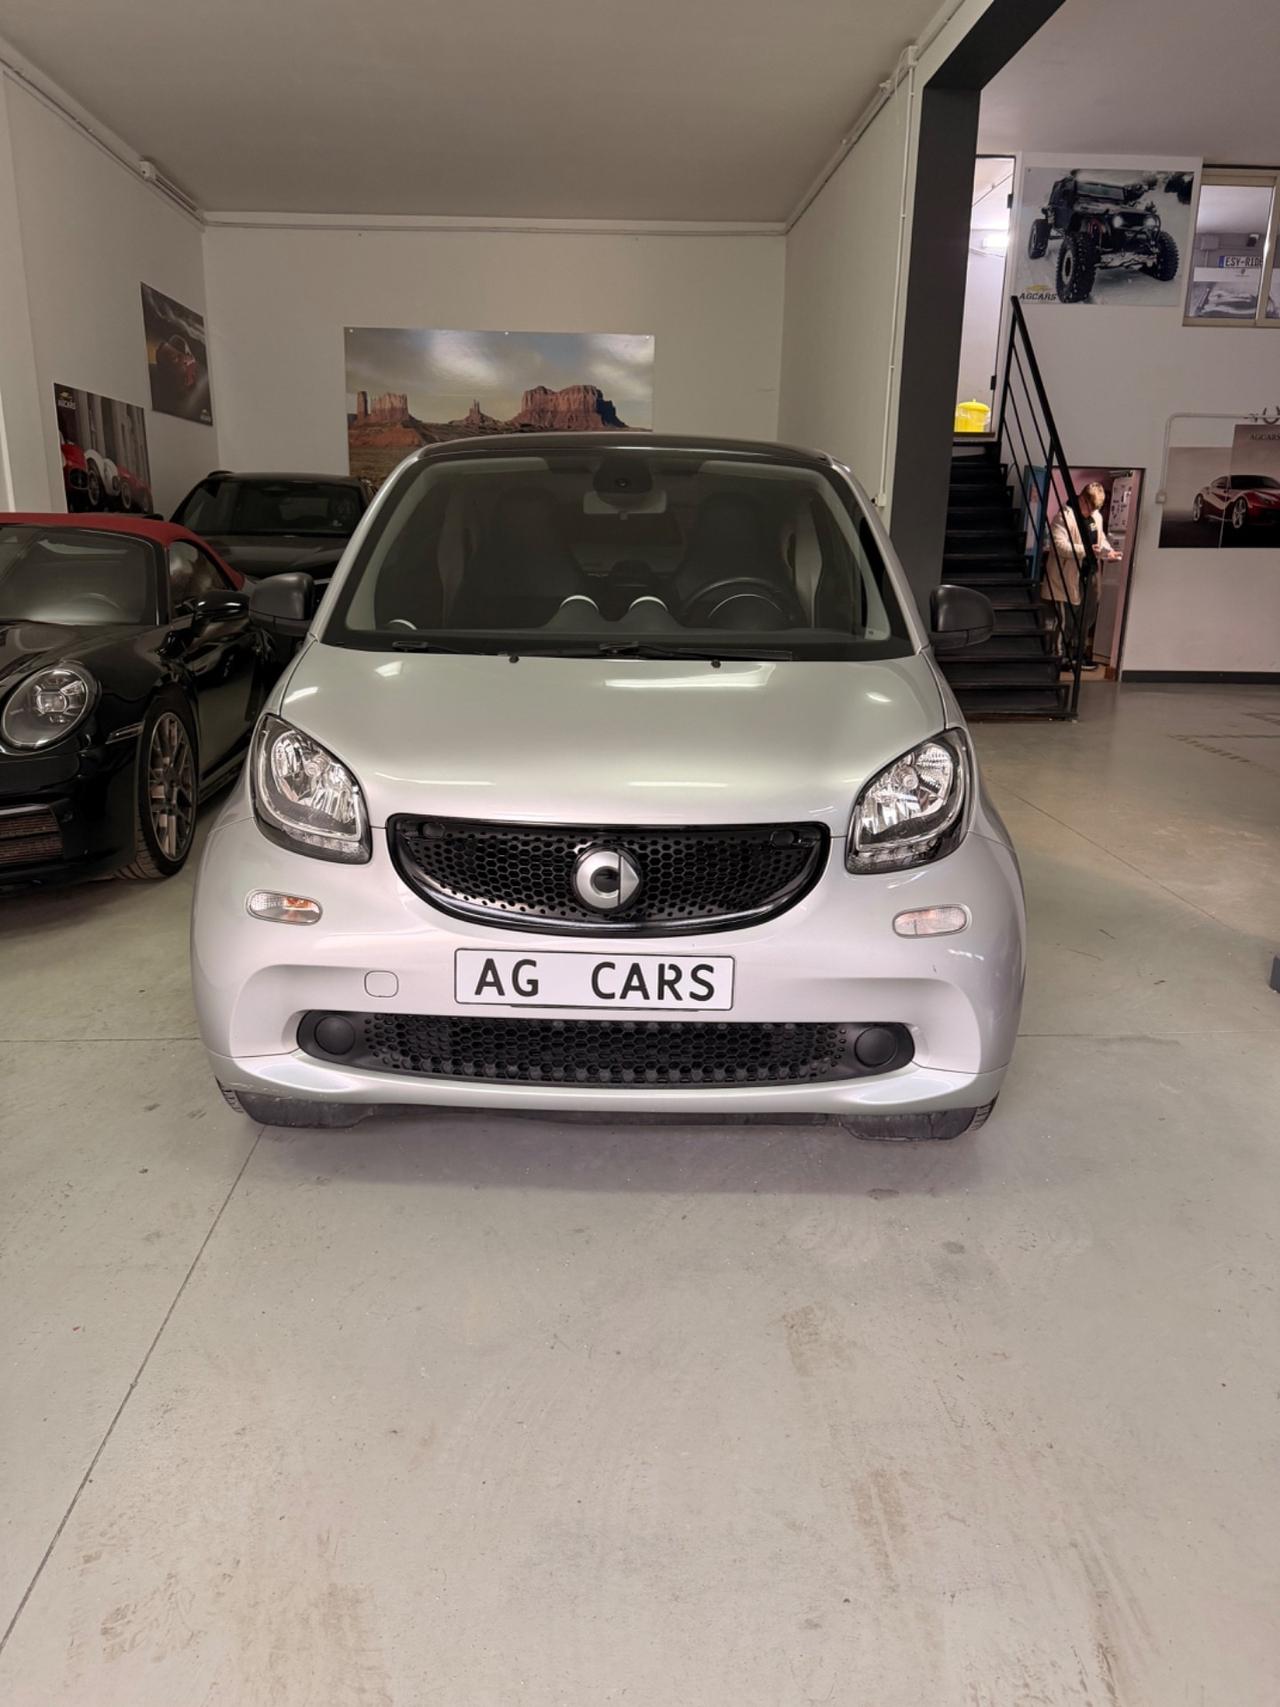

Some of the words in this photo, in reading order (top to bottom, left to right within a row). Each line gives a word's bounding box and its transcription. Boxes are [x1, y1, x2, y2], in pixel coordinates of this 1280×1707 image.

[1019, 292, 1057, 300] AGCARS
[475, 958, 539, 997] AG
[591, 961, 715, 1002] CARS
